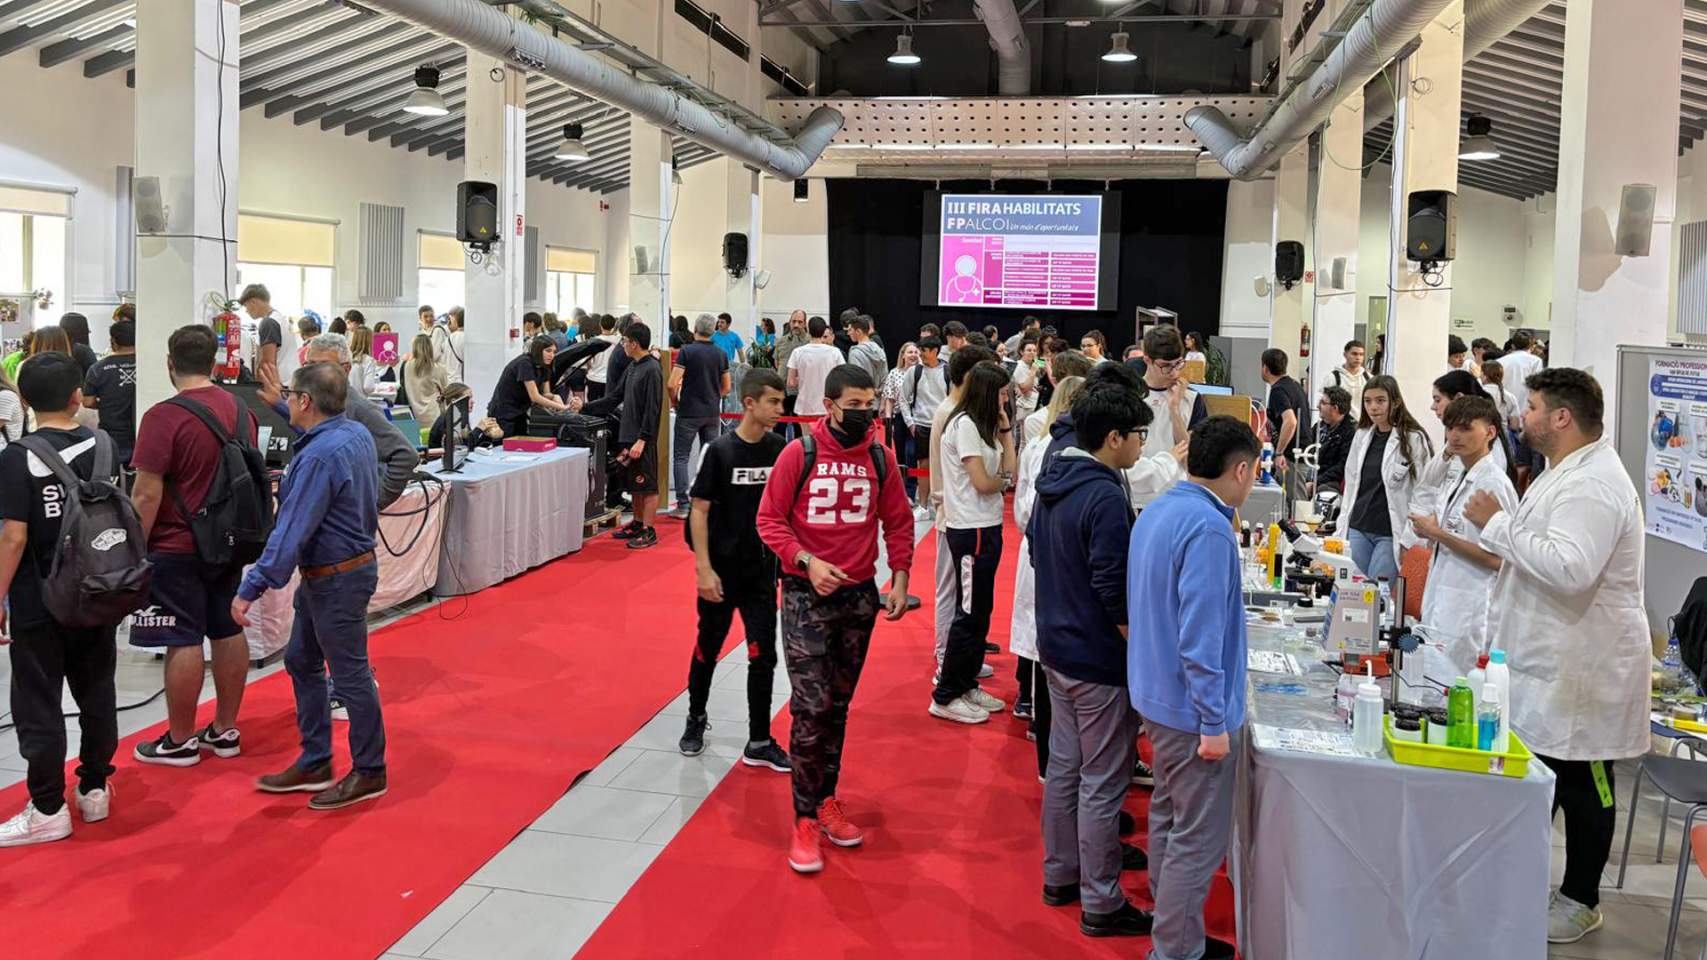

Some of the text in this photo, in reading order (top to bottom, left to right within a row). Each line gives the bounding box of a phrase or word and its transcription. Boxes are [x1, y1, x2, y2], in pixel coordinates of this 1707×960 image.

[948, 202, 1081, 215] III FIRA HABILITATS
[817, 462, 867, 476] RAMS
[737, 470, 768, 482] FILA
[807, 478, 871, 524] 23
